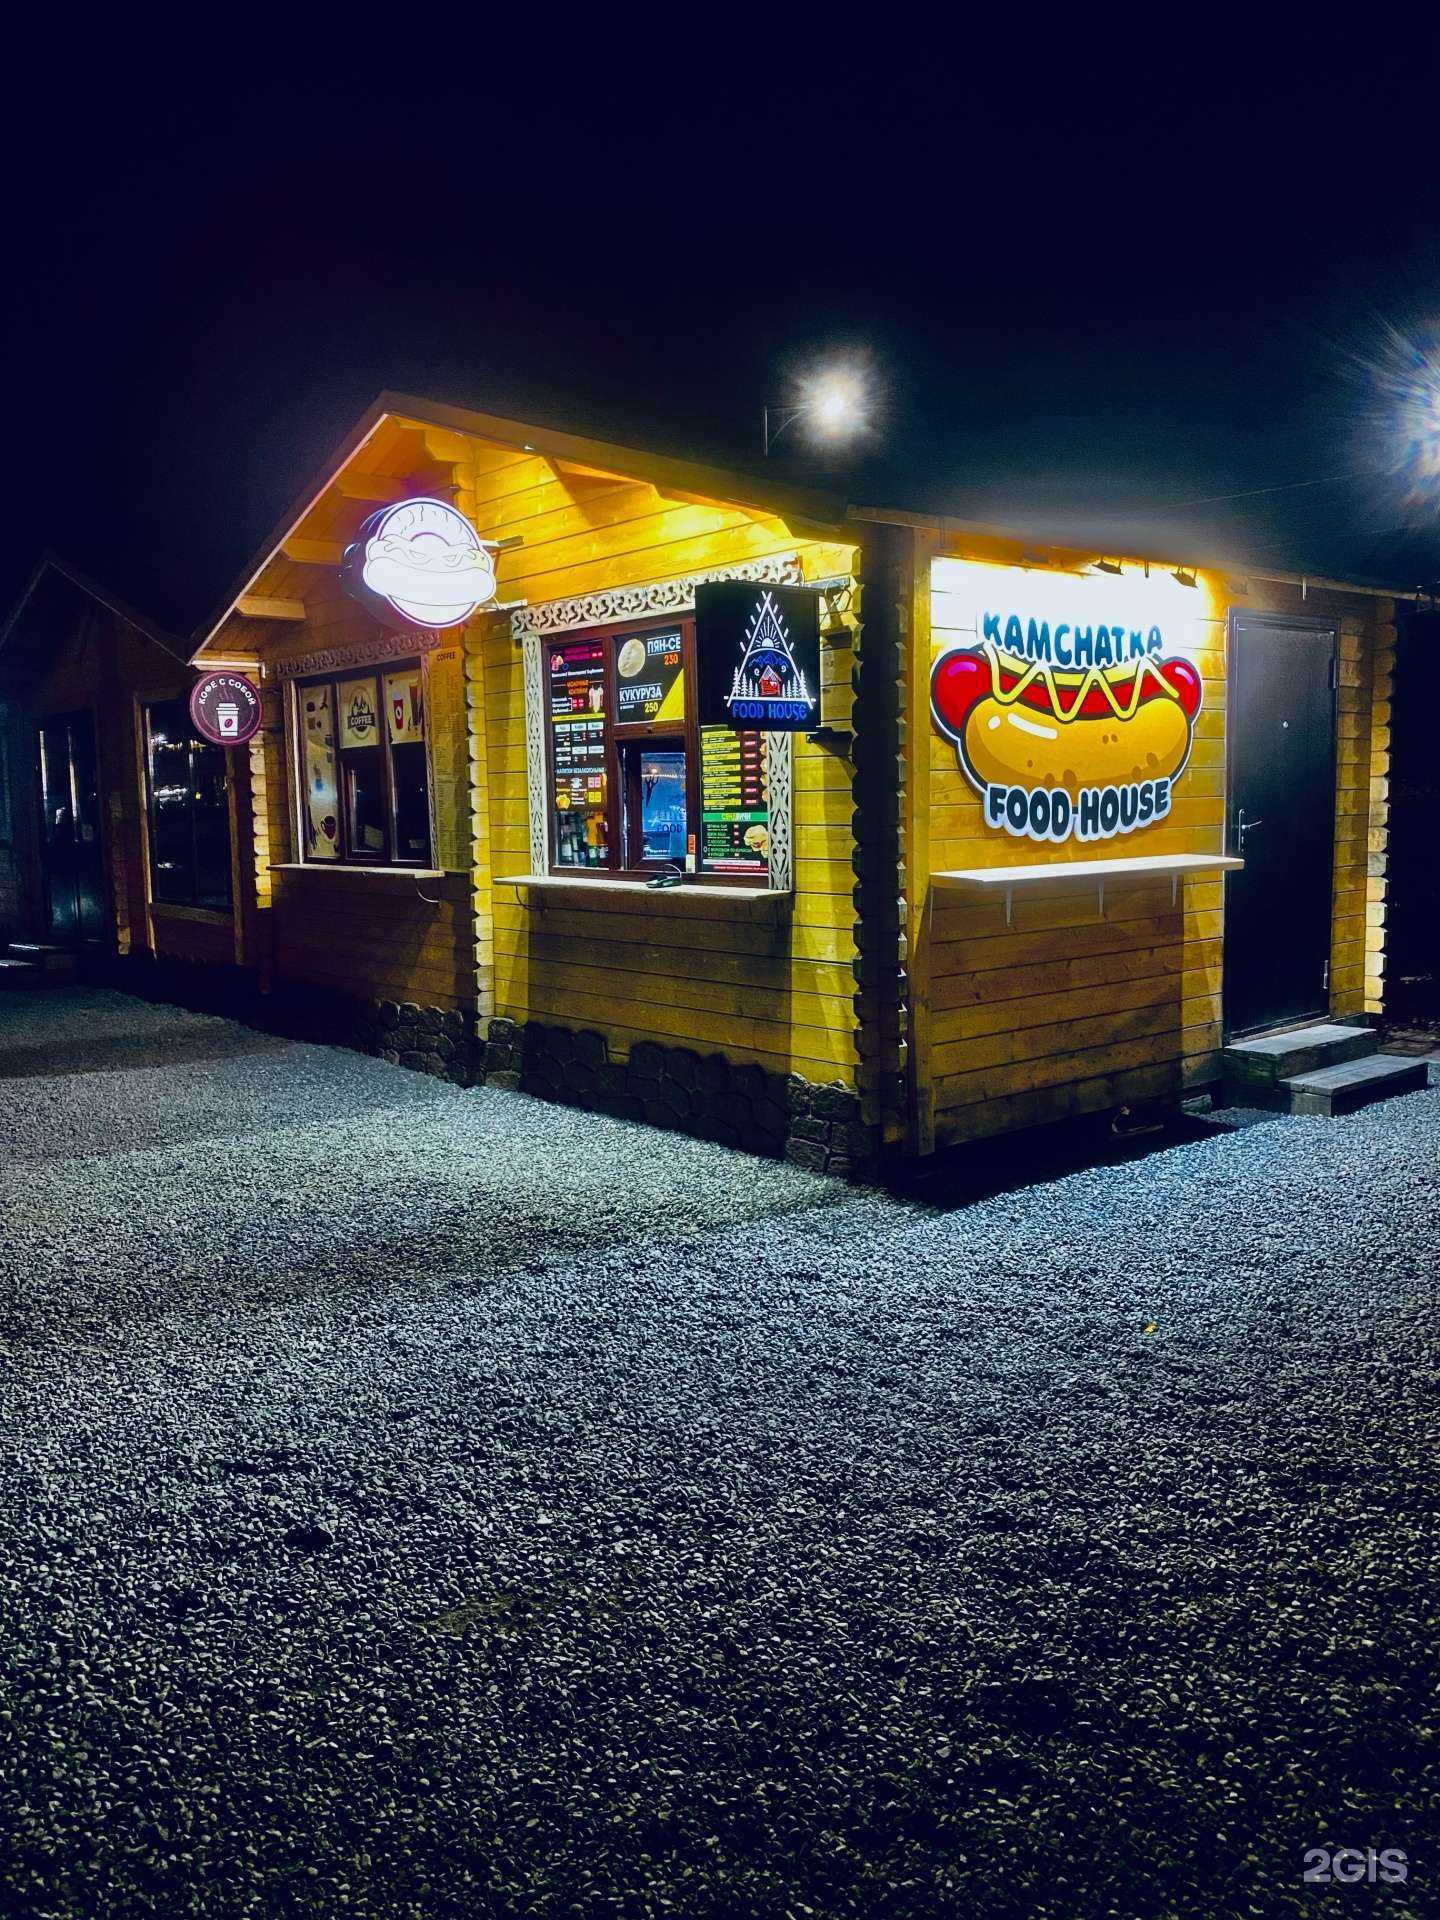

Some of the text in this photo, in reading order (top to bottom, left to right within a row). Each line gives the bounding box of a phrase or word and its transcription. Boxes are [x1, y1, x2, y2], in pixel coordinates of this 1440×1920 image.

[647, 637, 681, 654] ПЯН-СЕ
[436, 651, 455, 661] COFFEE
[198, 680, 218, 704] КОФЕ
[228, 678, 256, 705] СОБОЙ
[619, 686, 662, 702] КУКУРУЗА
[644, 702, 659, 713] 250
[732, 703, 807, 720] FOOD HOUSE
[350, 715, 372, 726] COFFEE
